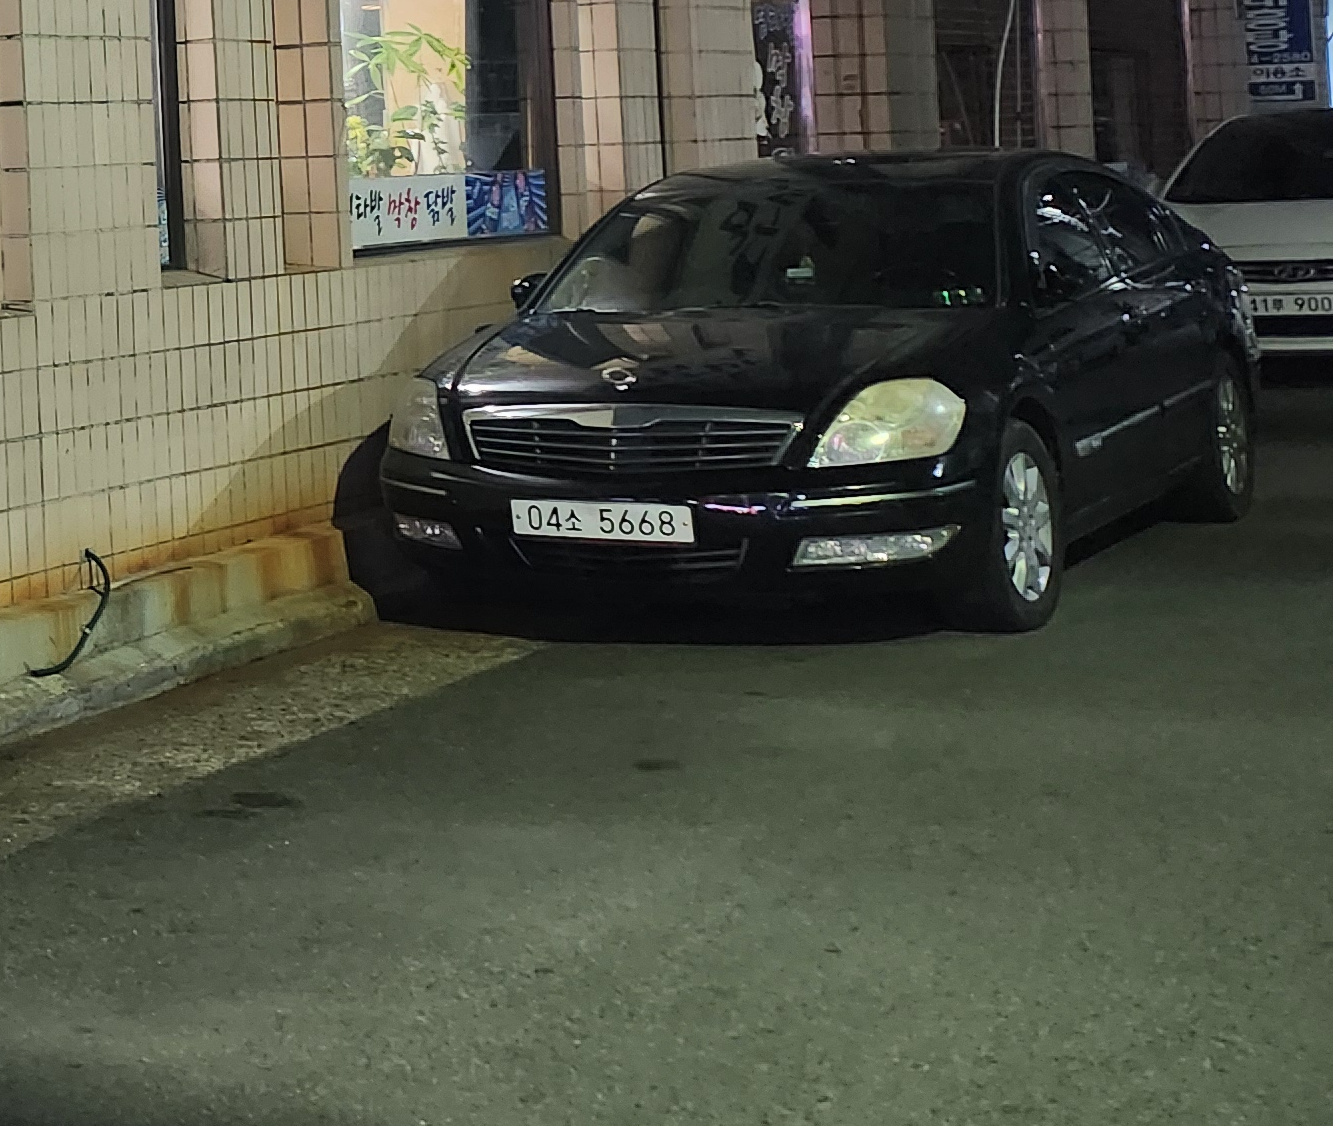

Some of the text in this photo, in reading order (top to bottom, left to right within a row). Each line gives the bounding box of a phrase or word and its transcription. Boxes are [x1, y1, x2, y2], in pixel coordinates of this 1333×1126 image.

[387, 187, 421, 230] 막창
[527, 504, 676, 536] 04소 5668
